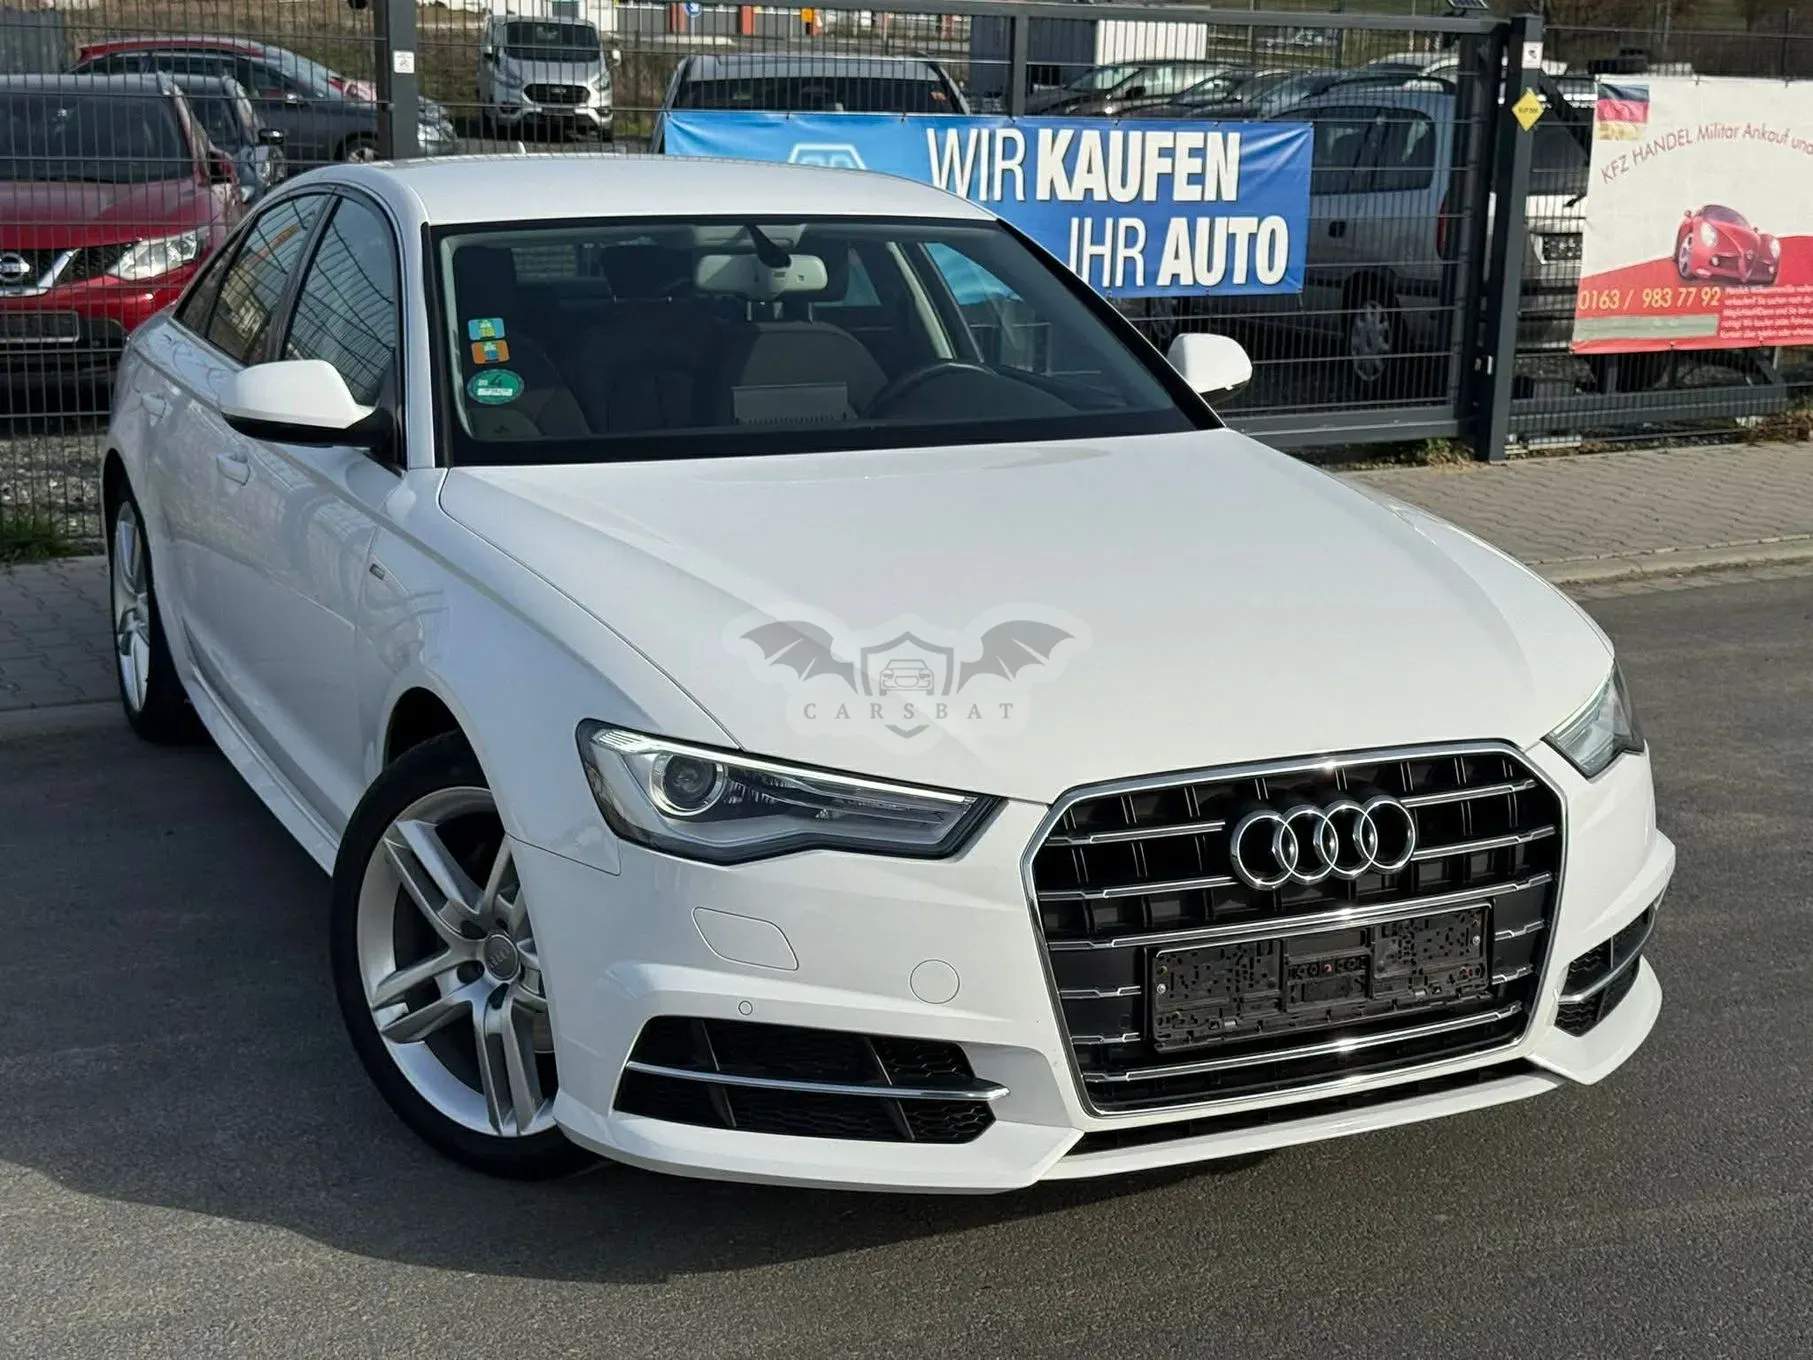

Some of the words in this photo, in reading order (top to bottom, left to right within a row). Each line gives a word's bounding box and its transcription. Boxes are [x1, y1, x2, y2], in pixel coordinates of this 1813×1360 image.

[926, 127, 1027, 201] WIR
[1035, 128, 1242, 202] KAUFEN
[1601, 155, 1630, 184] KFZ
[1632, 128, 1693, 166] HANDEL
[1743, 122, 1790, 145] Ankauf
[1068, 216, 1147, 288] IHR
[1156, 214, 1290, 287] AUTO
[1577, 289, 1620, 311] 0163
[1641, 287, 1673, 309] 983
[1676, 286, 1698, 308] 77
[1700, 286, 1722, 308] 92
